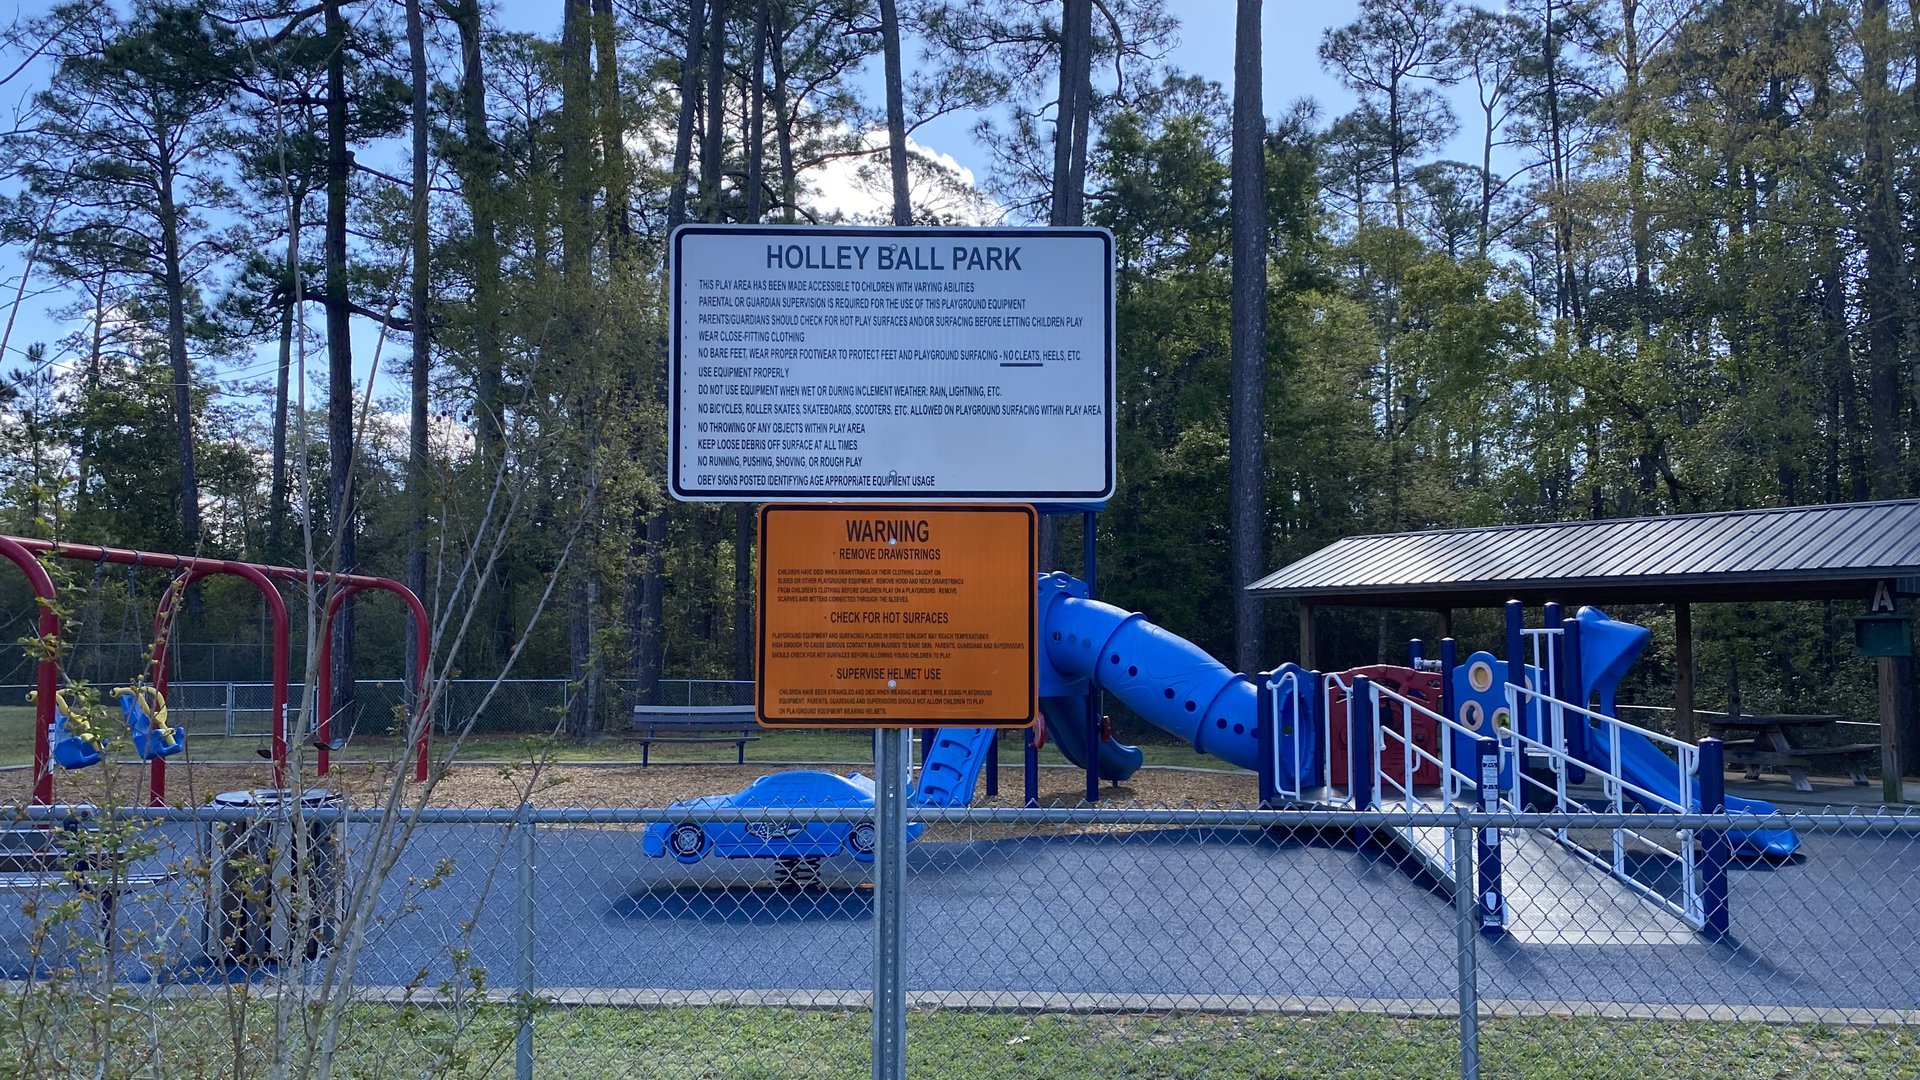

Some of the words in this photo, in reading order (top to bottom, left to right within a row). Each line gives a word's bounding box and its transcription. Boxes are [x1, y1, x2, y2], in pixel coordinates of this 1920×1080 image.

[767, 245, 869, 269] HOLLEY
[877, 246, 944, 270] BALL
[952, 246, 1021, 271] PARK
[699, 280, 714, 291] THIS
[715, 280, 732, 291] PLAY
[733, 280, 751, 291] AREA
[752, 280, 767, 291] HAS
[768, 280, 786, 291] BEEN
[787, 281, 807, 291] MADE
[808, 281, 849, 292] ACCESSIBLE
[851, 281, 860, 292] TO
[861, 281, 894, 292] CHILDREN
[896, 282, 912, 292] WITH
[913, 282, 942, 292] VARYING
[943, 282, 974, 293] ABILITIES
[698, 297, 733, 307] PARENTAL
[734, 297, 744, 307] OR
[745, 297, 781, 308] GUARDIAN
[782, 298, 826, 308] SUPERVISION
[827, 298, 833, 308] IS
[835, 298, 869, 308] REQUIRED
[870, 298, 884, 308] FOR
[886, 298, 898, 308] THE
[900, 298, 913, 309] USE
[914, 298, 923, 309] OF
[926, 298, 940, 309] THIS
[941, 299, 986, 309] PLAYGROUND
[987, 299, 1025, 309] EQUIPMENT
[771, 315, 798, 326] SHOULD
[800, 315, 822, 326] CHECK
[824, 315, 838, 326] FOR
[839, 315, 853, 326] HOT
[854, 315, 871, 326] PLAY
[872, 316, 907, 326] SURFACES
[935, 316, 973, 327] SURFACING
[974, 316, 1001, 327] BEFORE
[1002, 316, 1030, 327] LETTING
[1031, 317, 1064, 327] CHILDREN
[1066, 317, 1082, 328] PLAY
[698, 331, 718, 341] WEAR
[719, 331, 769, 342] CLOSE-FITTING
[770, 332, 804, 342] CLOTHING
[698, 348, 708, 358] NO
[709, 348, 728, 358] BARE
[729, 348, 747, 360] FEET,
[749, 348, 769, 358] WEAR
[770, 348, 797, 359] PROPER
[799, 349, 836, 359] FOOTWEAR
[839, 349, 847, 359] TO
[848, 349, 878, 359] PROTECT
[880, 349, 896, 359] FEET
[898, 349, 912, 360] AND
[914, 349, 959, 360] PLAYGROUND
[960, 350, 998, 360] SURFACING
[1003, 350, 1013, 360] NO
[1014, 350, 1042, 362] CLEATS,
[1042, 350, 1066, 362] HEELS,
[1067, 350, 1082, 361] ETC.
[698, 367, 712, 377] USE
[713, 367, 751, 378] EQUIPMENT
[753, 368, 788, 378] PROPERLY
[698, 384, 708, 395] DO
[709, 385, 722, 395] NOT
[725, 385, 738, 395] USE
[740, 385, 777, 395] EQUIPMENT
[779, 385, 799, 395] WHEN
[801, 385, 815, 395] WET
[816, 385, 827, 396] OR
[828, 385, 854, 396] DURING
[855, 385, 892, 396] INCLEMENT
[929, 386, 948, 397] RAIN,
[948, 386, 985, 398] LIGHTNING,
[987, 386, 1002, 397] ETC.
[698, 404, 708, 414] NO
[709, 404, 744, 415] BICYCLES,
[745, 404, 772, 414] ROLLER
[802, 404, 853, 415] SKATEBOARDS,
[894, 404, 909, 414] ETC.
[910, 405, 942, 415] ALLOWED
[944, 405, 954, 415] ON
[955, 405, 1000, 415] PLAYGROUND
[1002, 405, 1039, 415] SURFACING
[1041, 405, 1063, 415] WITHIN
[1065, 405, 1081, 415] PLAY
[1083, 405, 1101, 415] AREA
[697, 423, 708, 433] NO
[710, 423, 745, 433] THROWING
[746, 423, 756, 433] OF
[757, 423, 770, 433] ANY
[772, 423, 803, 433] OBJECTS
[804, 423, 827, 433] WITHIN
[829, 423, 845, 433] PLAY
[846, 423, 865, 433] AREA
[697, 440, 715, 449] KEEP
[716, 440, 739, 450] LOOSE
[741, 440, 766, 450] DEBRIS
[767, 440, 780, 450] OFF
[781, 440, 813, 450] SURFACE
[814, 440, 821, 450] AT
[823, 440, 836, 450] ALL
[838, 440, 857, 450] TIMES
[697, 456, 707, 467] NO
[708, 456, 741, 468] RUNNING,
[742, 457, 774, 468] PUSHING,
[808, 457, 818, 467] OR
[819, 457, 844, 467] ROUGH
[845, 457, 862, 467] PLAY
[697, 475, 716, 486] OBEY
[717, 475, 737, 486] SIGNS
[739, 475, 766, 486] POSTED
[767, 475, 808, 486] IDENTIFYING
[809, 475, 824, 486] AGE
[825, 475, 871, 486] APPROPRIATE
[872, 476, 909, 486] EQUIPMENT
[911, 476, 935, 486] USAGE
[846, 520, 929, 542] WARNING
[839, 549, 875, 560] REMOVE
[877, 549, 940, 560] DRAWSTRINGS
[1871, 580, 1894, 611] A
[830, 612, 860, 623] CHECK
[862, 612, 880, 623] FOR
[882, 612, 899, 623] HOT
[902, 612, 948, 623] SURFACES
[836, 668, 884, 679] SUPERVISE
[887, 668, 920, 679] HELMET
[924, 669, 941, 679] USE
